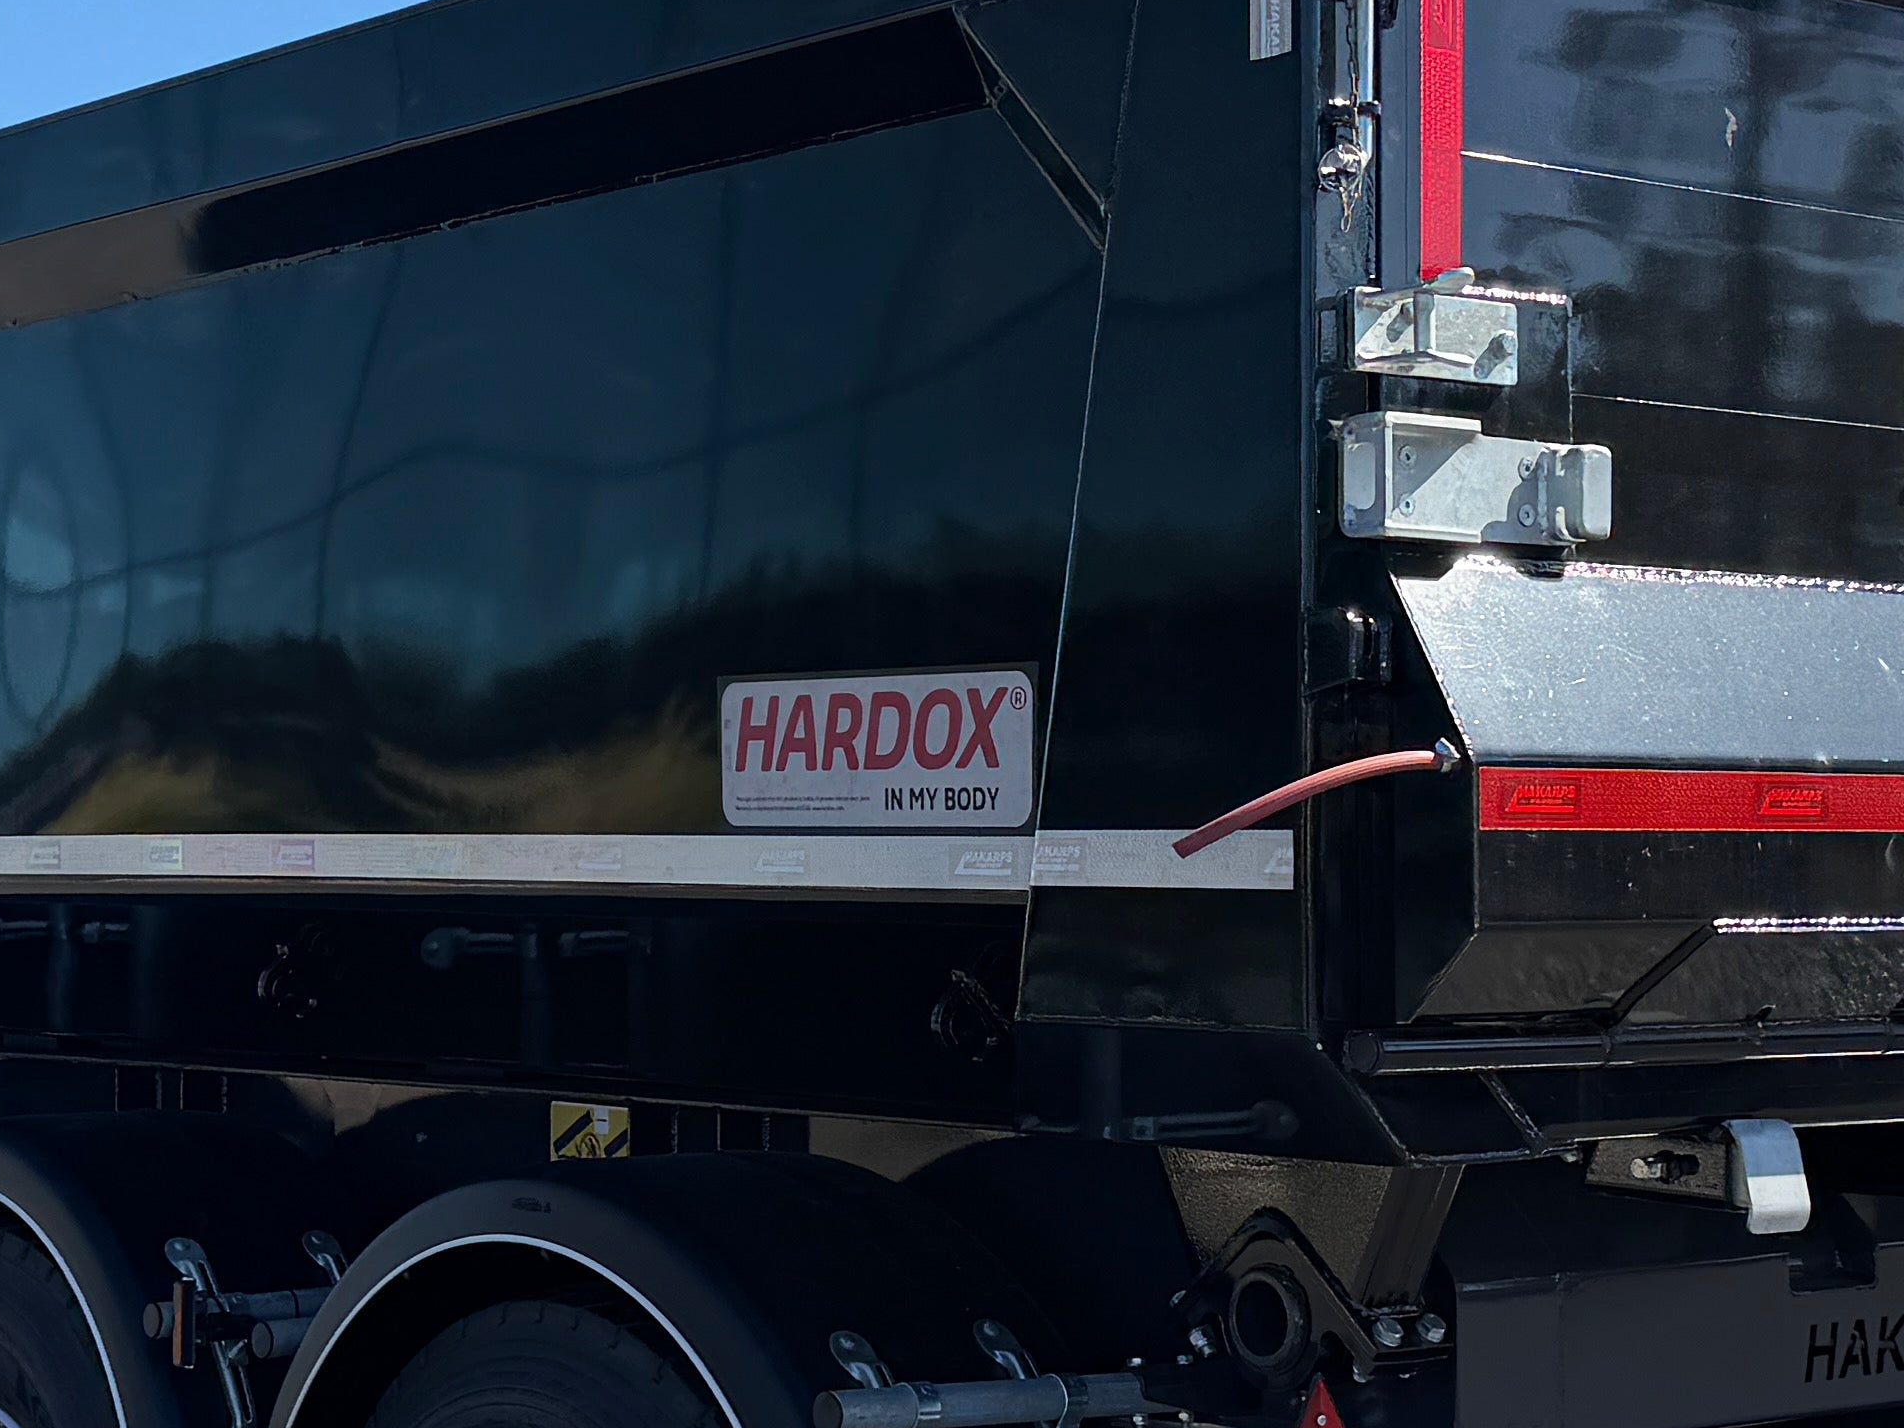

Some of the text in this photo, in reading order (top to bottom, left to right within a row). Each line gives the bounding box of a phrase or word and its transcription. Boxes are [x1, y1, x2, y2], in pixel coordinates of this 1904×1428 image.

[884, 787, 1000, 811] IN MY BODY
